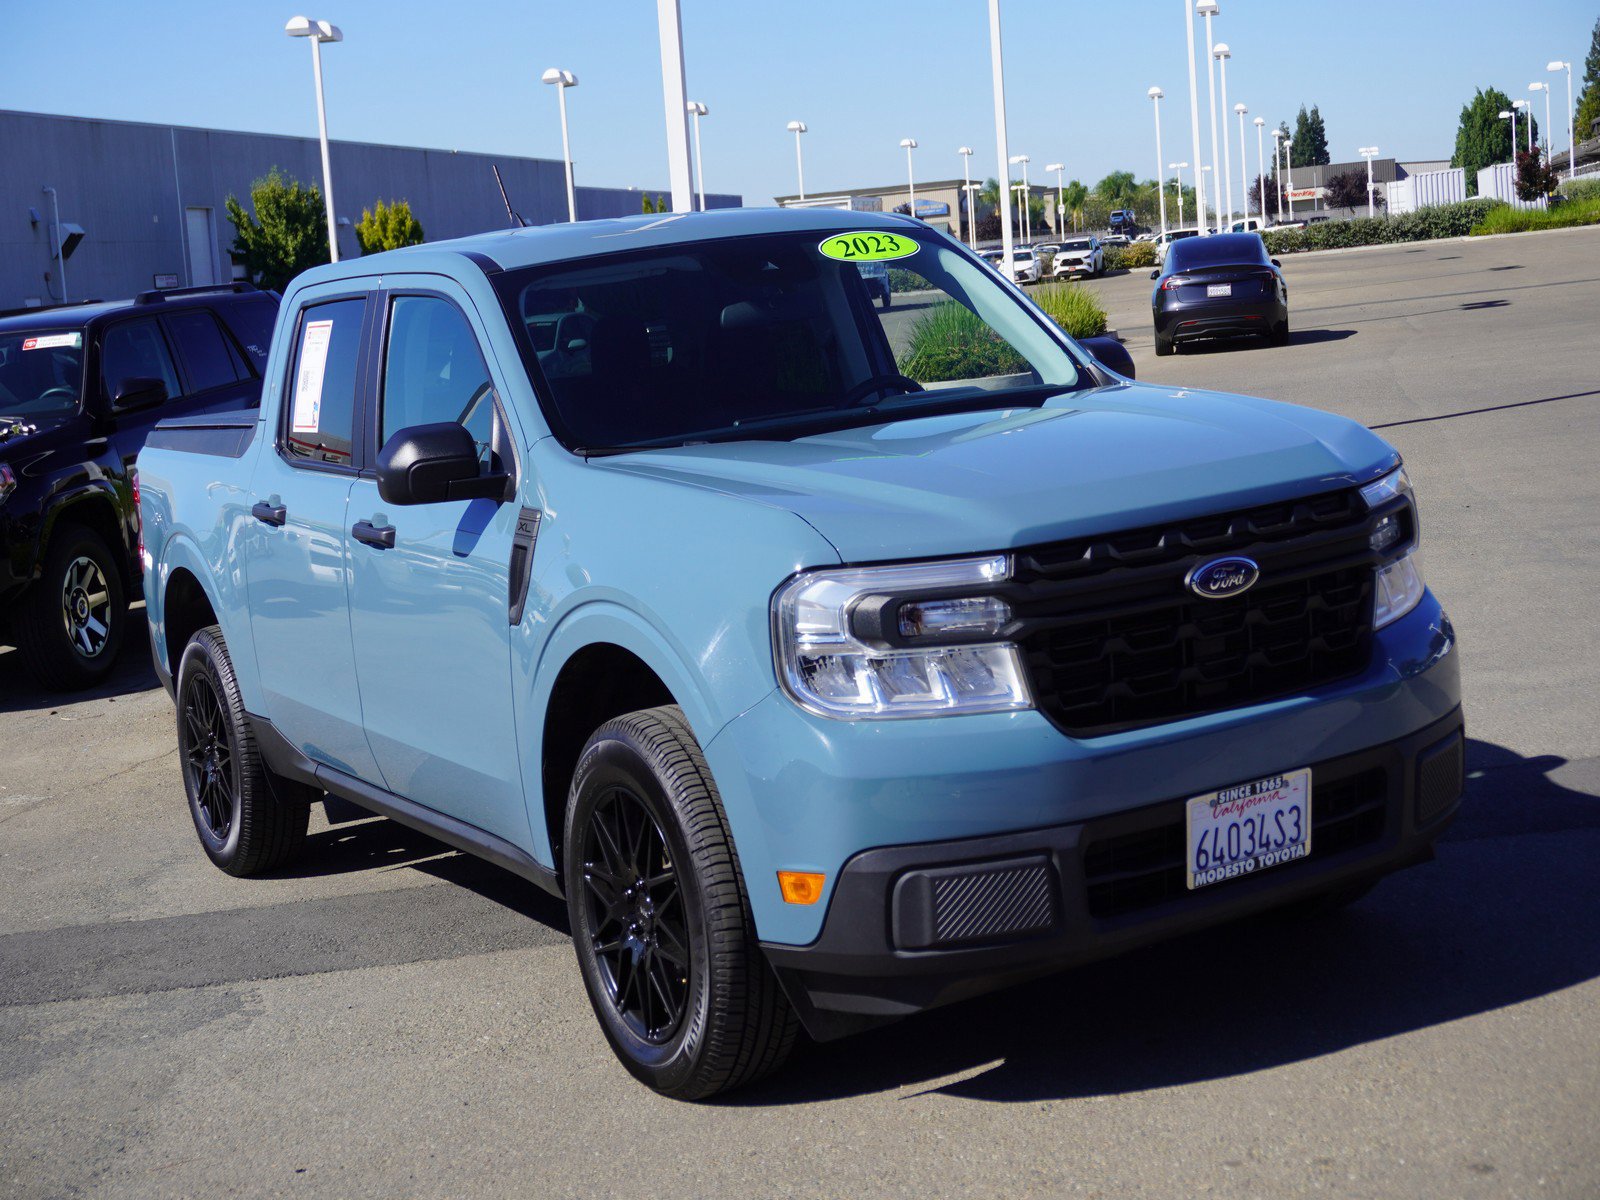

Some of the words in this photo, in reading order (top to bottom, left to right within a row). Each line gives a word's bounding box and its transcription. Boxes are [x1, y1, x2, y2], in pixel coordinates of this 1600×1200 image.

[836, 235, 900, 257] 2023
[518, 522, 531, 533] XL
[1210, 567, 1245, 590] Ford
[1218, 785, 1251, 803] SINCE
[1256, 777, 1282, 794] 1965
[1212, 791, 1287, 819] California
[1196, 805, 1301, 870] 64034S3
[1195, 859, 1254, 887] MODESTO
[1258, 844, 1305, 868] TOYOTA
[686, 971, 704, 1054] MICHELIN
